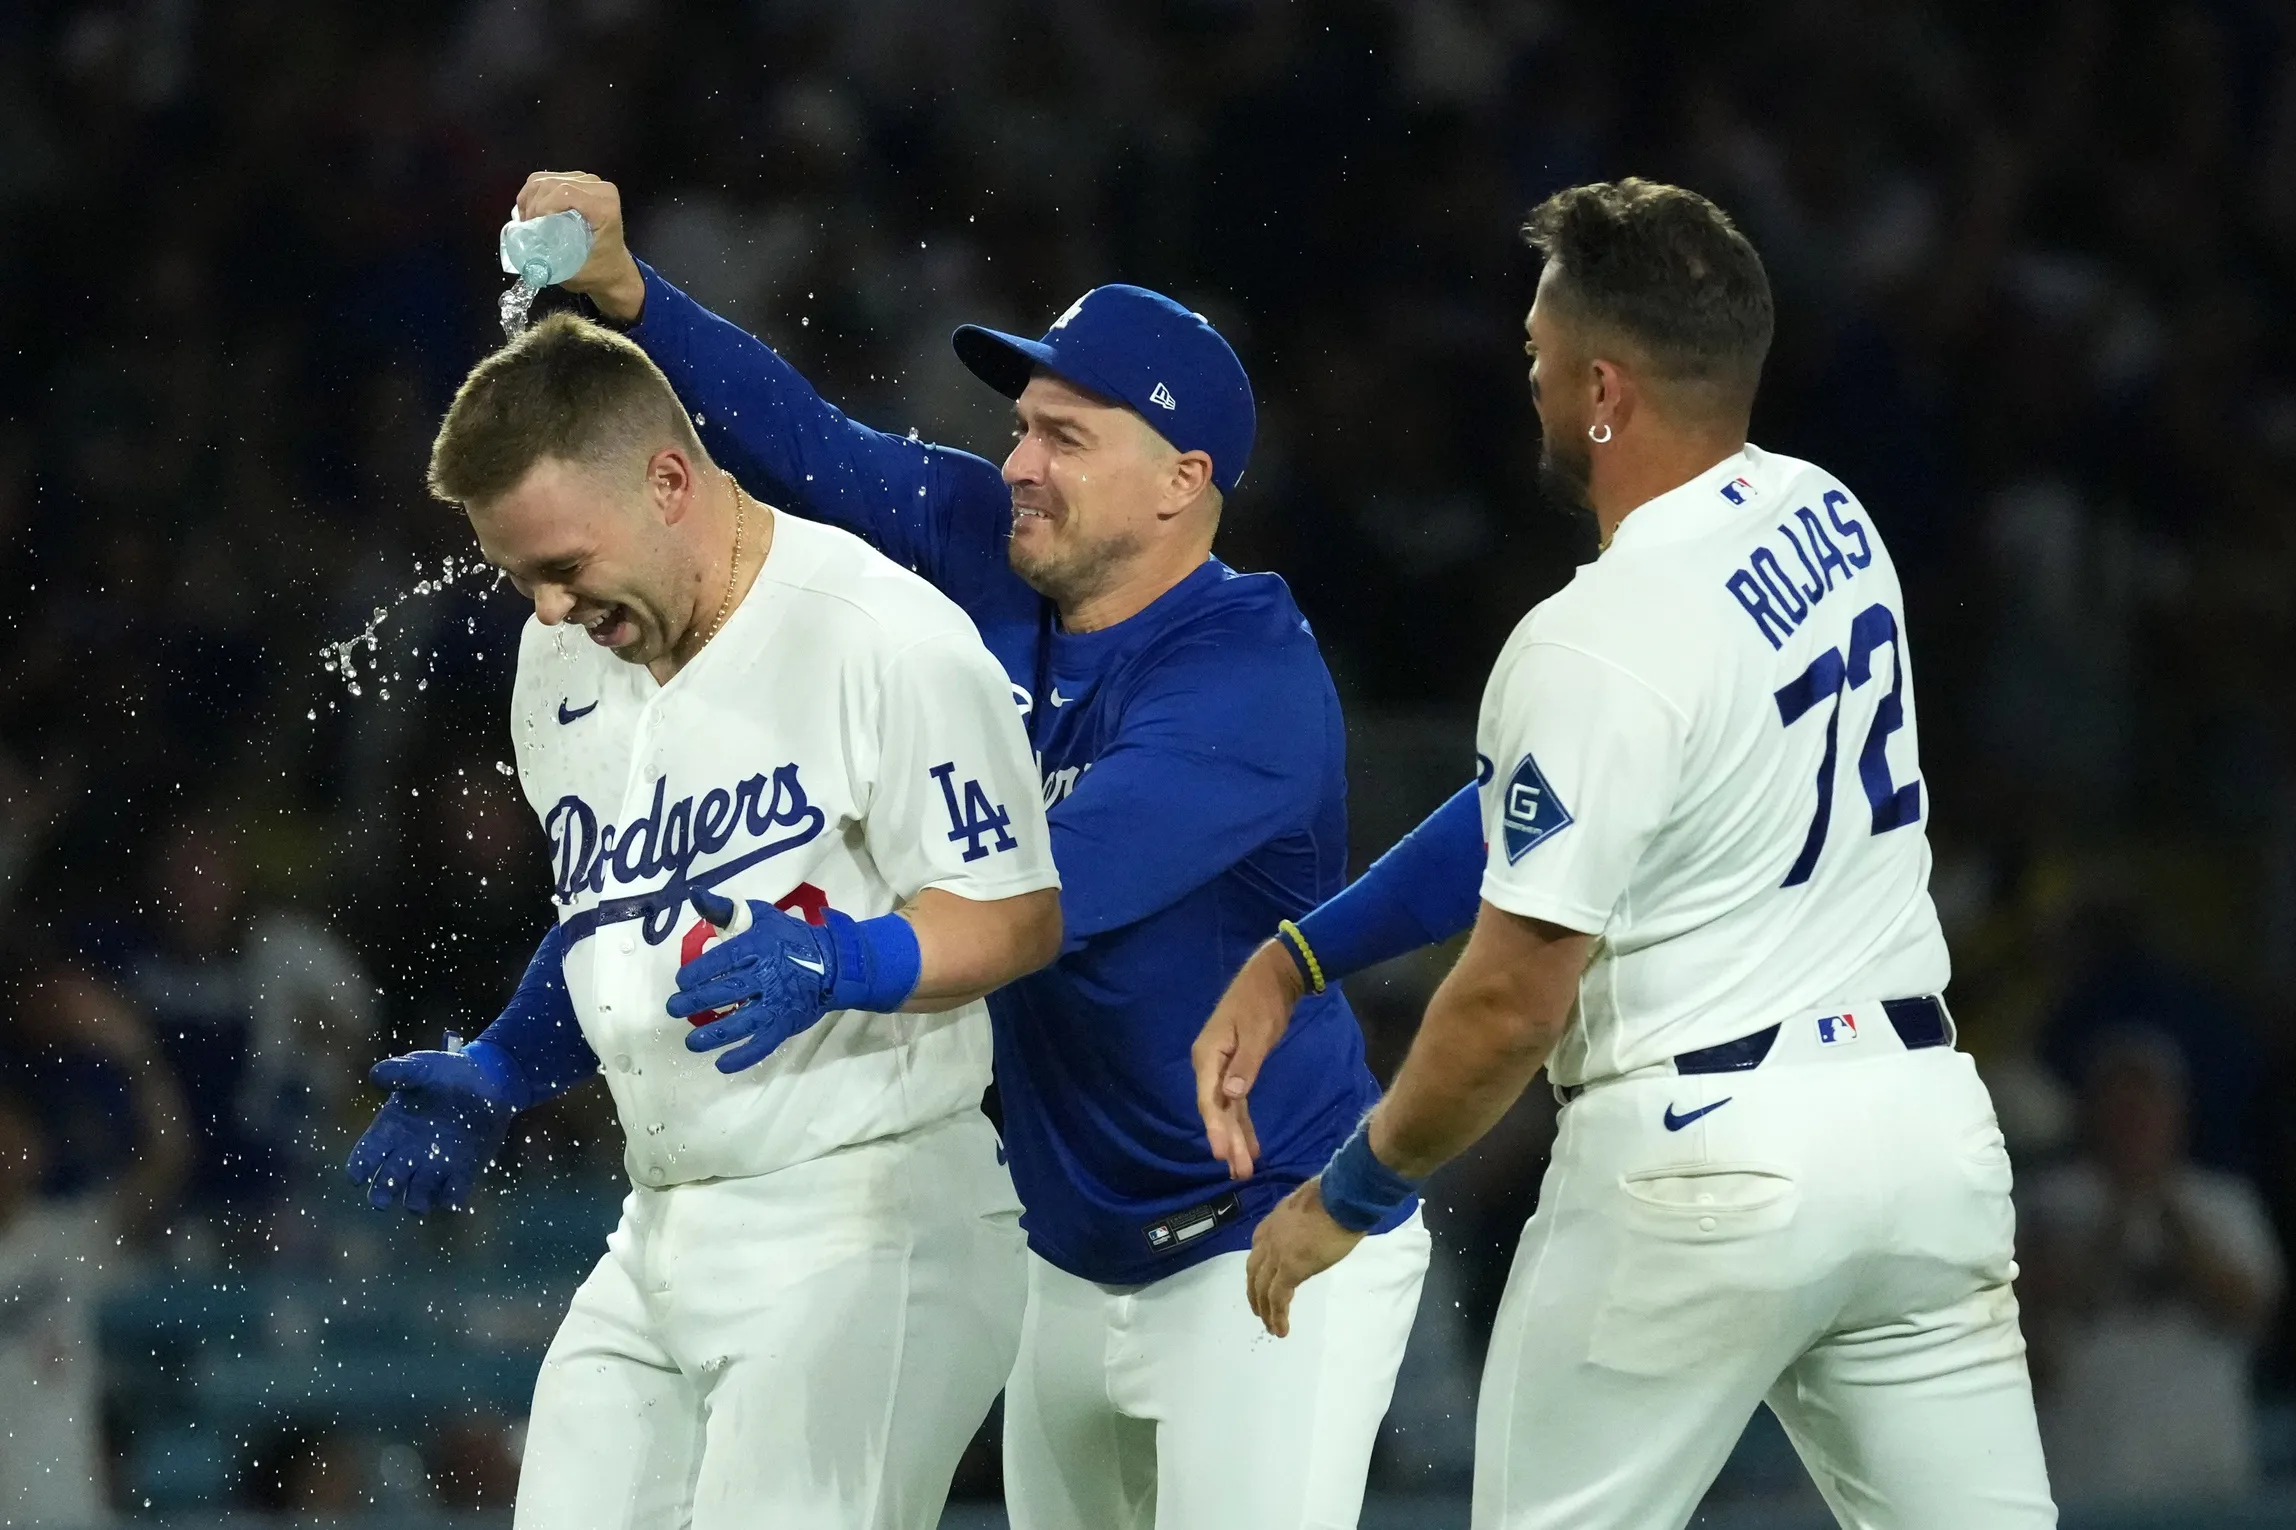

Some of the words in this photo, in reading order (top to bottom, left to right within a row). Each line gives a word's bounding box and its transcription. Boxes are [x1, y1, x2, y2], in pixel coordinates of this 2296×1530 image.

[1725, 489, 1872, 651] ROJAS
[931, 762, 1018, 863] LA
[1509, 783, 1540, 821] G
[1774, 603, 1920, 888] 72
[545, 761, 824, 945] Dodgers
